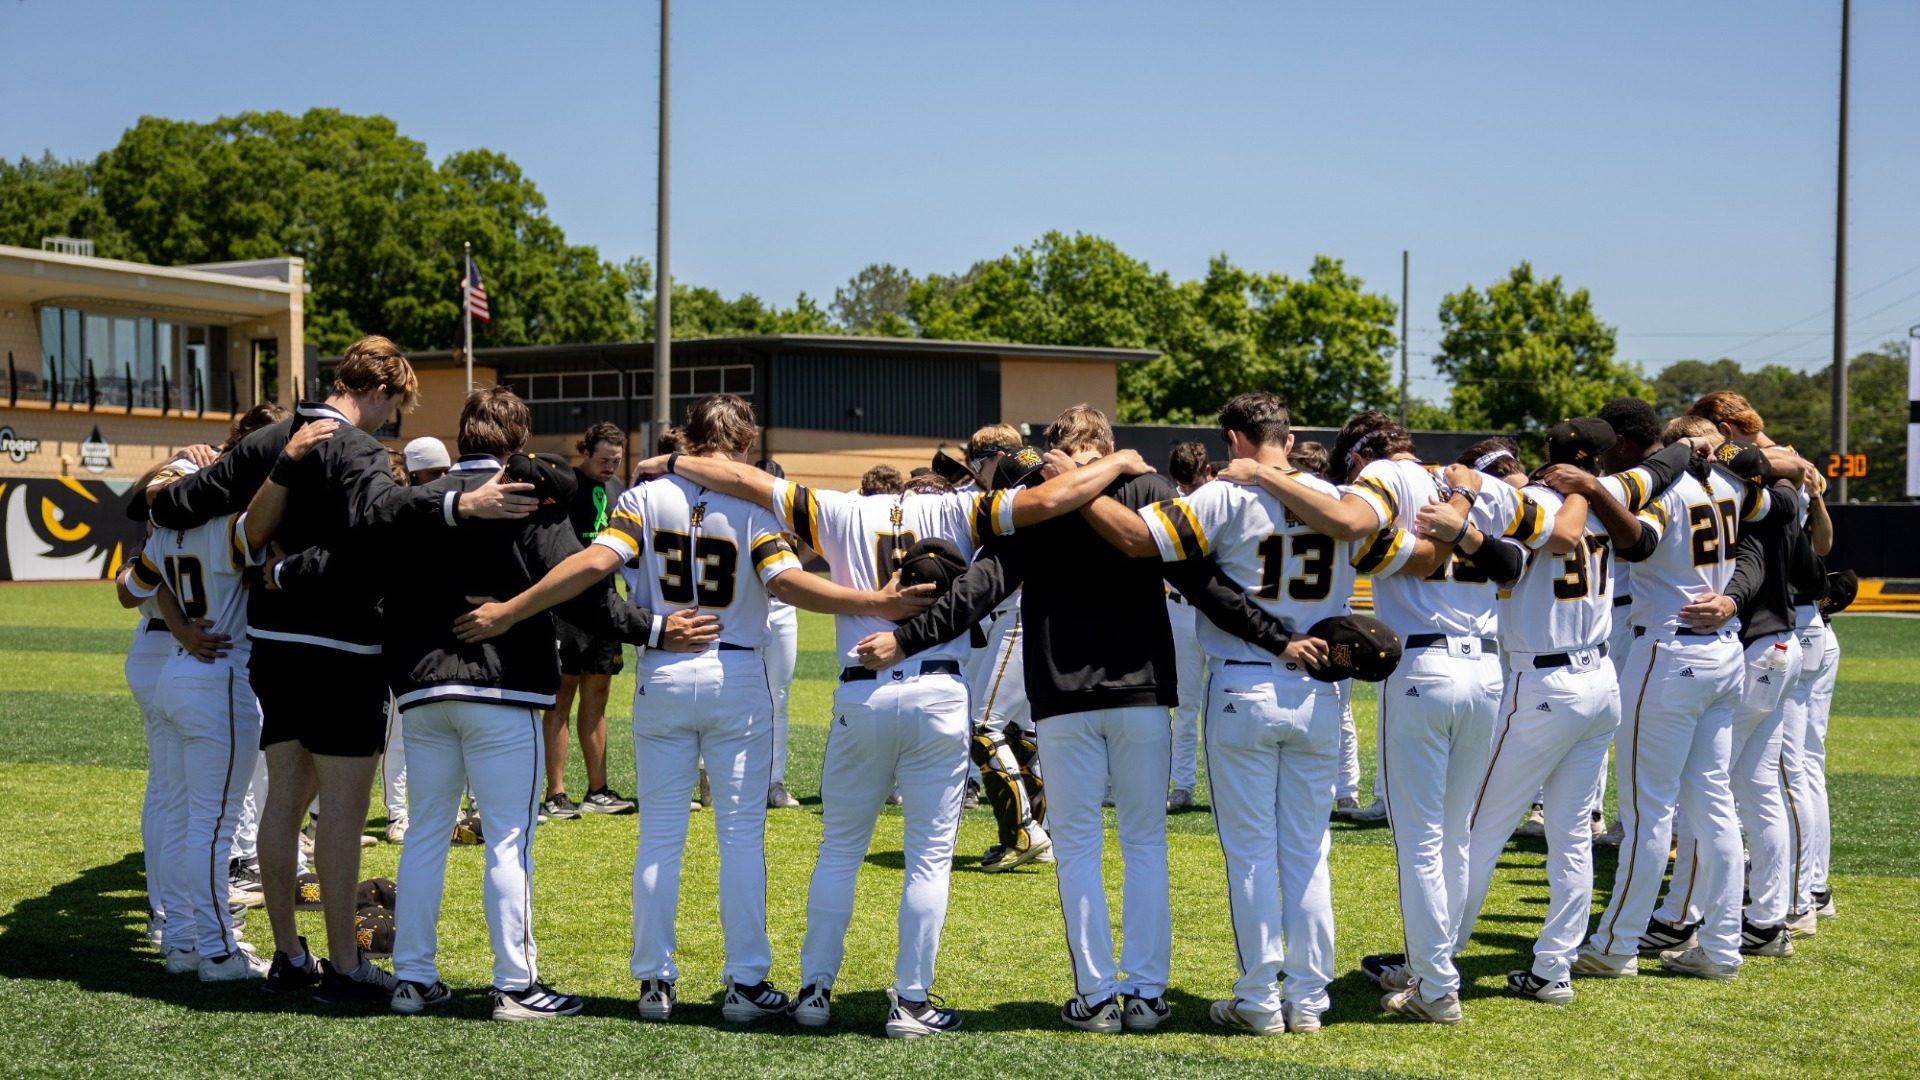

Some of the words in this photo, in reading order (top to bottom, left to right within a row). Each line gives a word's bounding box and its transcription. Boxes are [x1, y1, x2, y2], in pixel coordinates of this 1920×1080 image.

[652, 527, 739, 610] 33
[1255, 531, 1336, 603] 13
[1552, 533, 1611, 601] 37
[1687, 498, 1737, 569] 20
